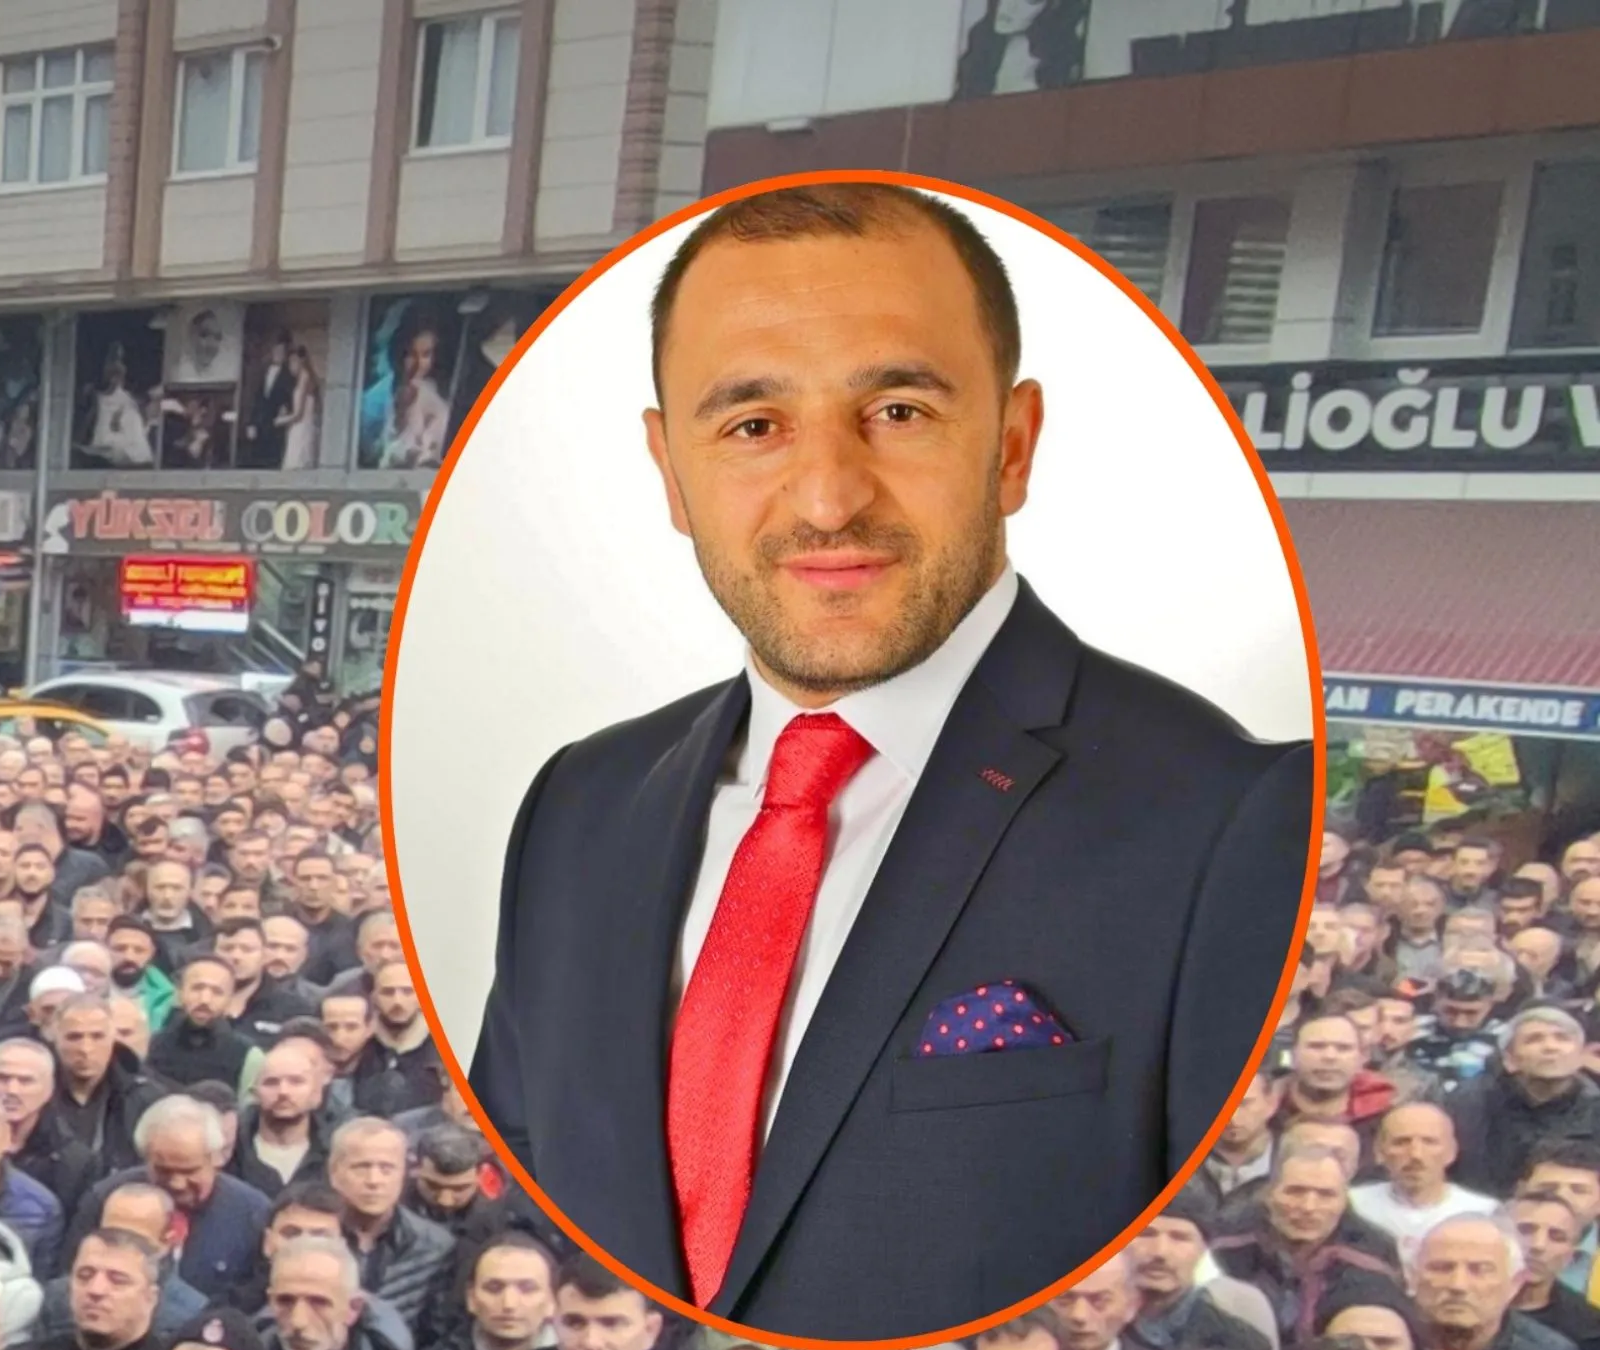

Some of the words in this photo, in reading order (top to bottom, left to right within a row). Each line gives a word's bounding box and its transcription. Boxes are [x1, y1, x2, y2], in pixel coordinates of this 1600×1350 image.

[66, 489, 225, 542] YÜKSEL
[240, 500, 411, 546] COLOR
[1323, 685, 1371, 710] AN
[1394, 689, 1584, 726] PERAKENDE
